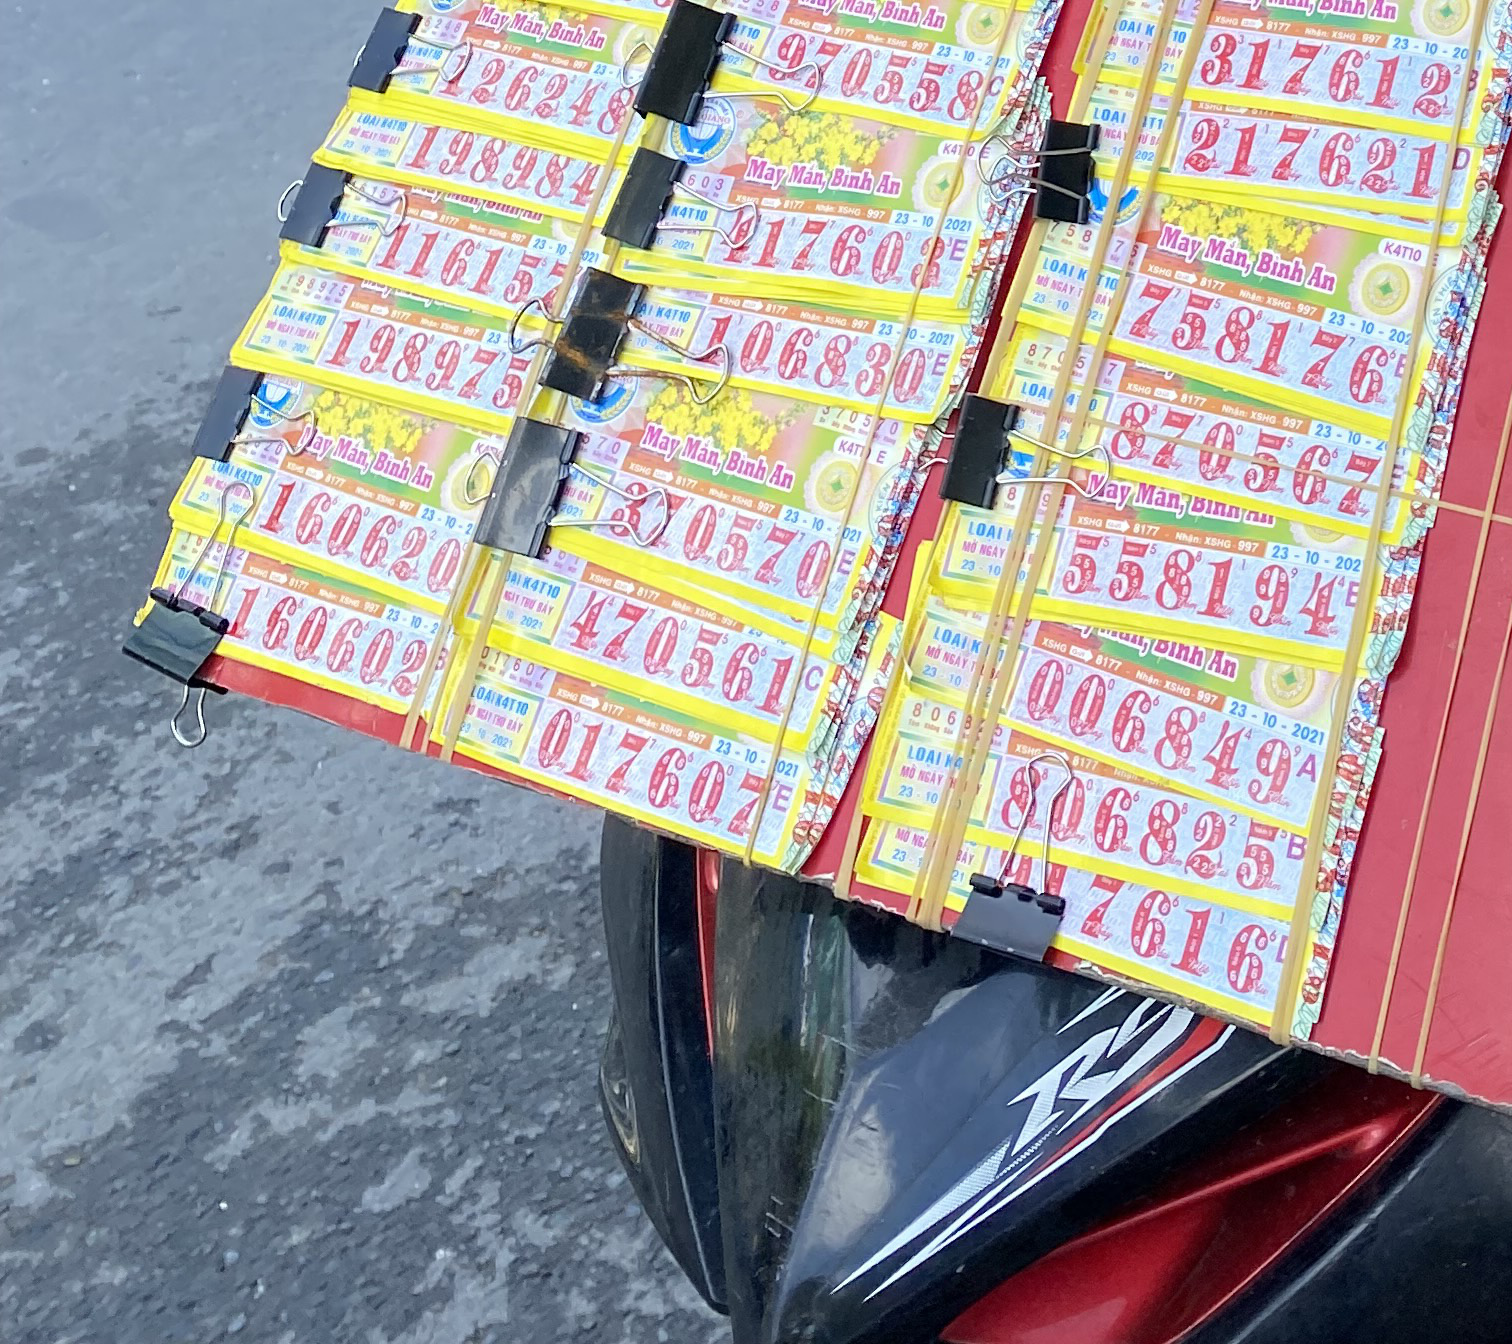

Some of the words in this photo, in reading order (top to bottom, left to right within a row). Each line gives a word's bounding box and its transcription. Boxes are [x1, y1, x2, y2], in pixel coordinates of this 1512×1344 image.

[477, 6, 507, 32] May
[548, 21, 585, 47] Bình
[585, 32, 605, 50] An
[881, 2, 921, 25] Bình
[921, 8, 947, 29] An
[1372, 0, 1398, 22] An
[438, 52, 634, 135] 126248
[768, 32, 983, 121] 970558
[1200, 33, 1453, 119] 317612
[405, 125, 602, 208] 198984
[745, 158, 784, 185] May
[829, 169, 873, 193] Bình
[875, 177, 902, 196] An
[1183, 117, 1440, 199] 217621
[721, 210, 945, 289] 417603
[949, 236, 968, 262] E
[1146, 263, 1173, 278] XSHG
[1200, 276, 1226, 292] 8177
[1265, 295, 1292, 311] XSHG
[1296, 303, 1318, 318] 997
[1160, 225, 1203, 257] May
[1256, 254, 1305, 286] Bình
[1307, 265, 1337, 294] An
[1383, 240, 1422, 262] K4T10
[326, 318, 532, 410] 198975
[696, 314, 928, 403] 106830
[931, 352, 950, 376] E
[1130, 282, 1388, 404] 758176
[373, 451, 412, 481] Bình
[411, 466, 434, 490] An
[642, 425, 683, 456] May
[726, 451, 766, 480] Bình
[768, 462, 796, 489] An
[1110, 401, 1383, 516] 870567
[259, 480, 461, 594] 160620
[609, 483, 831, 598] 370570
[1076, 515, 1103, 530] XSHG
[1132, 522, 1160, 538] 8177
[1203, 537, 1232, 551] XSHG
[1236, 540, 1259, 554] 997
[1062, 534, 1343, 639] 558194
[224, 586, 428, 697] 160602
[569, 588, 796, 716] 470561
[803, 667, 824, 692] C
[1040, 636, 1068, 655] XSHG
[1095, 653, 1124, 672] 8177
[1162, 678, 1192, 697] XSHG
[1196, 689, 1219, 706] 997
[1026, 658, 1294, 805] 006849
[1296, 751, 1319, 783] A
[1228, 701, 1253, 719] 23
[1260, 710, 1279, 729] 10
[1291, 721, 1326, 746] 2021
[537, 708, 770, 836] 017607
[771, 787, 793, 811] E
[1000, 765, 1278, 892] 806825
[1285, 830, 1306, 858] B
